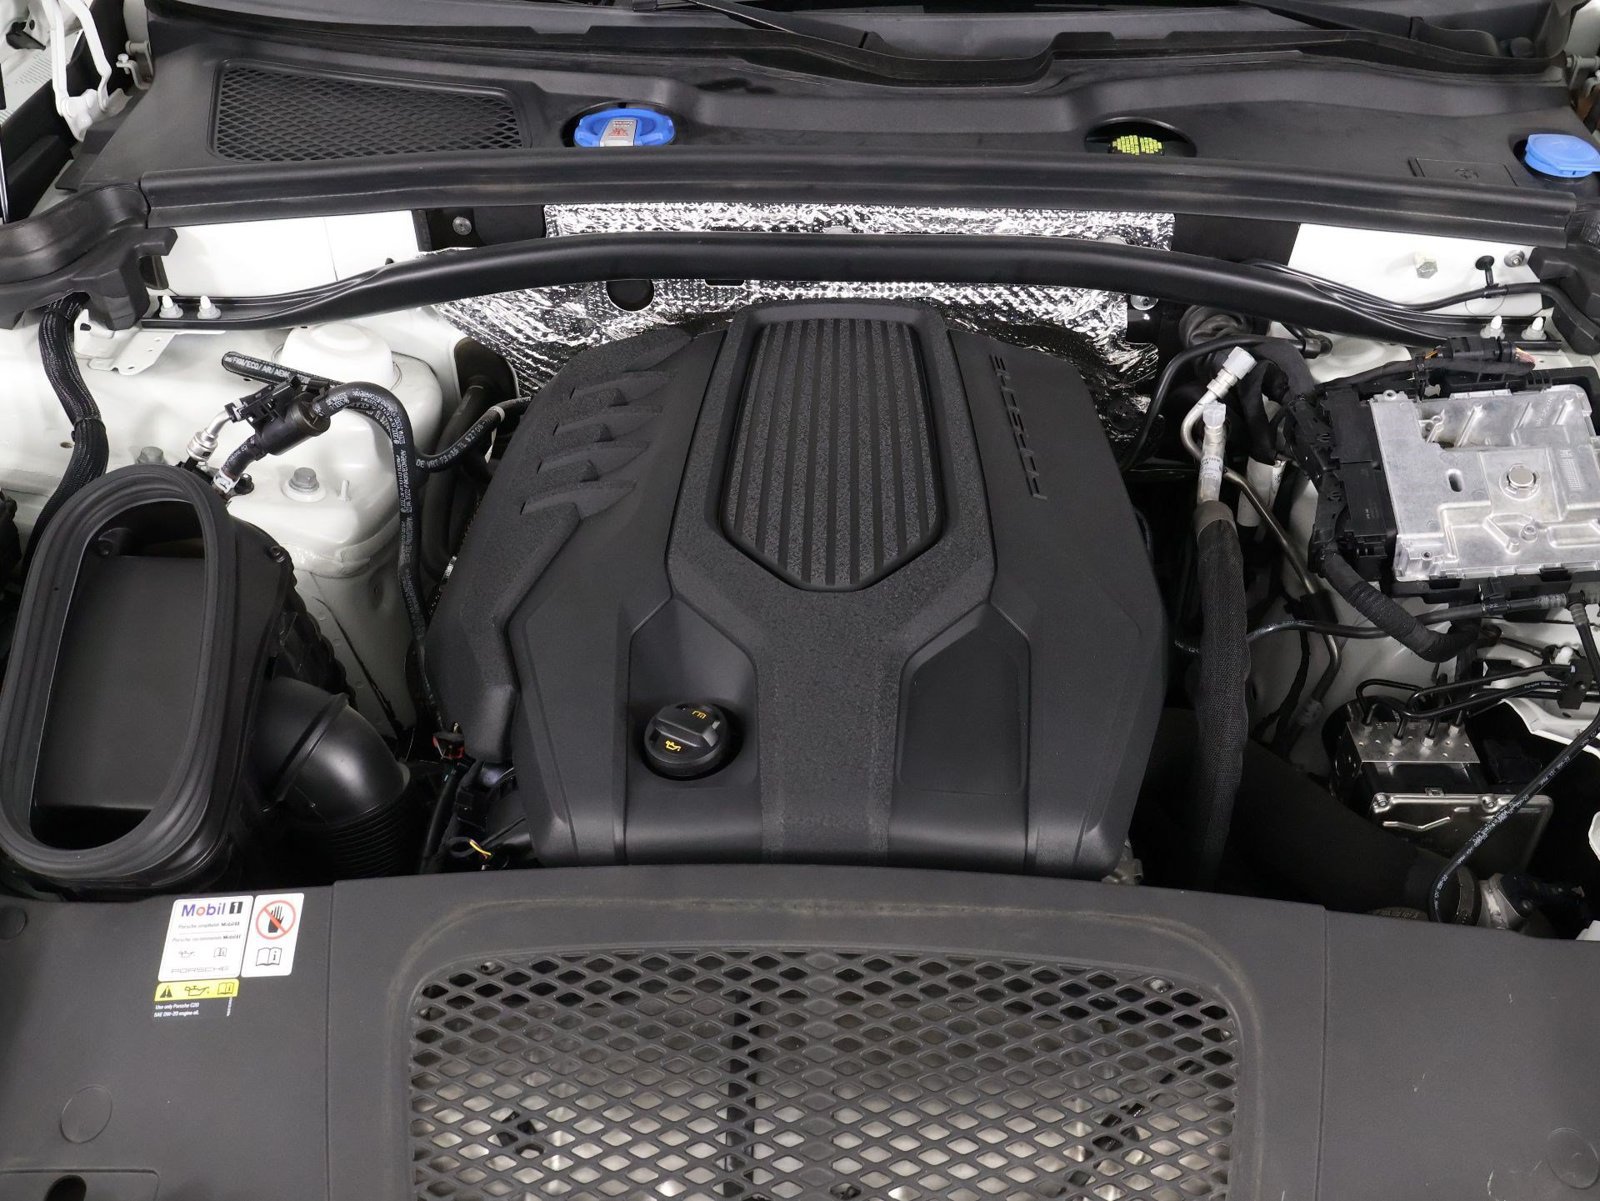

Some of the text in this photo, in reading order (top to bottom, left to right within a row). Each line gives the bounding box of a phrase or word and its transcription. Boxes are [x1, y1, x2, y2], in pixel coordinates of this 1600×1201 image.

[989, 353, 1047, 500] PORSCHE
[180, 901, 243, 918] Mobil 1
